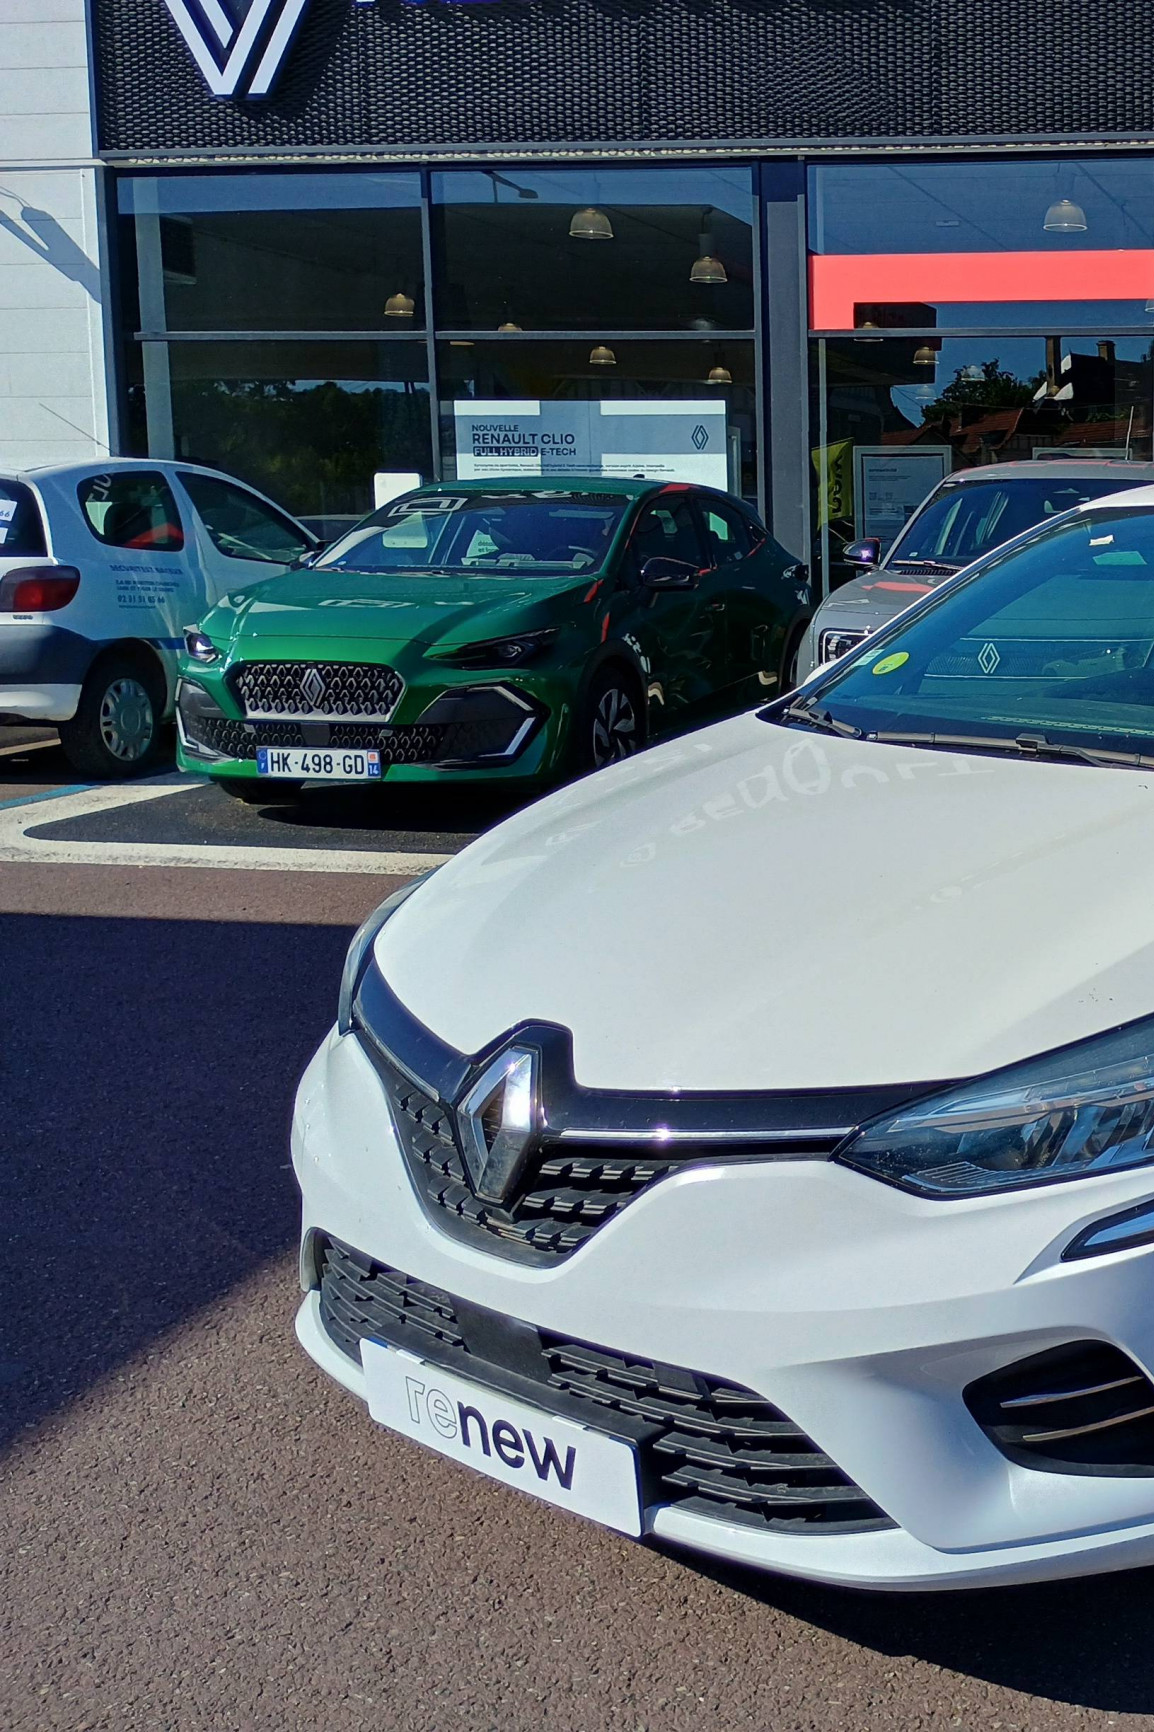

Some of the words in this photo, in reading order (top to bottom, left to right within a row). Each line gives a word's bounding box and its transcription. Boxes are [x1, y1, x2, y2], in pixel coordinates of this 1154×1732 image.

[472, 424, 519, 432] NOUVELLE
[472, 433, 538, 445] RENAULT
[541, 433, 575, 445] CLIO
[474, 447, 498, 456] FULL
[500, 447, 538, 456] HYBRID
[541, 448, 576, 456] E-TECH
[270, 752, 365, 775] HK-498-GD
[368, 764, 379, 775] 14
[405, 1376, 577, 1491] renew
